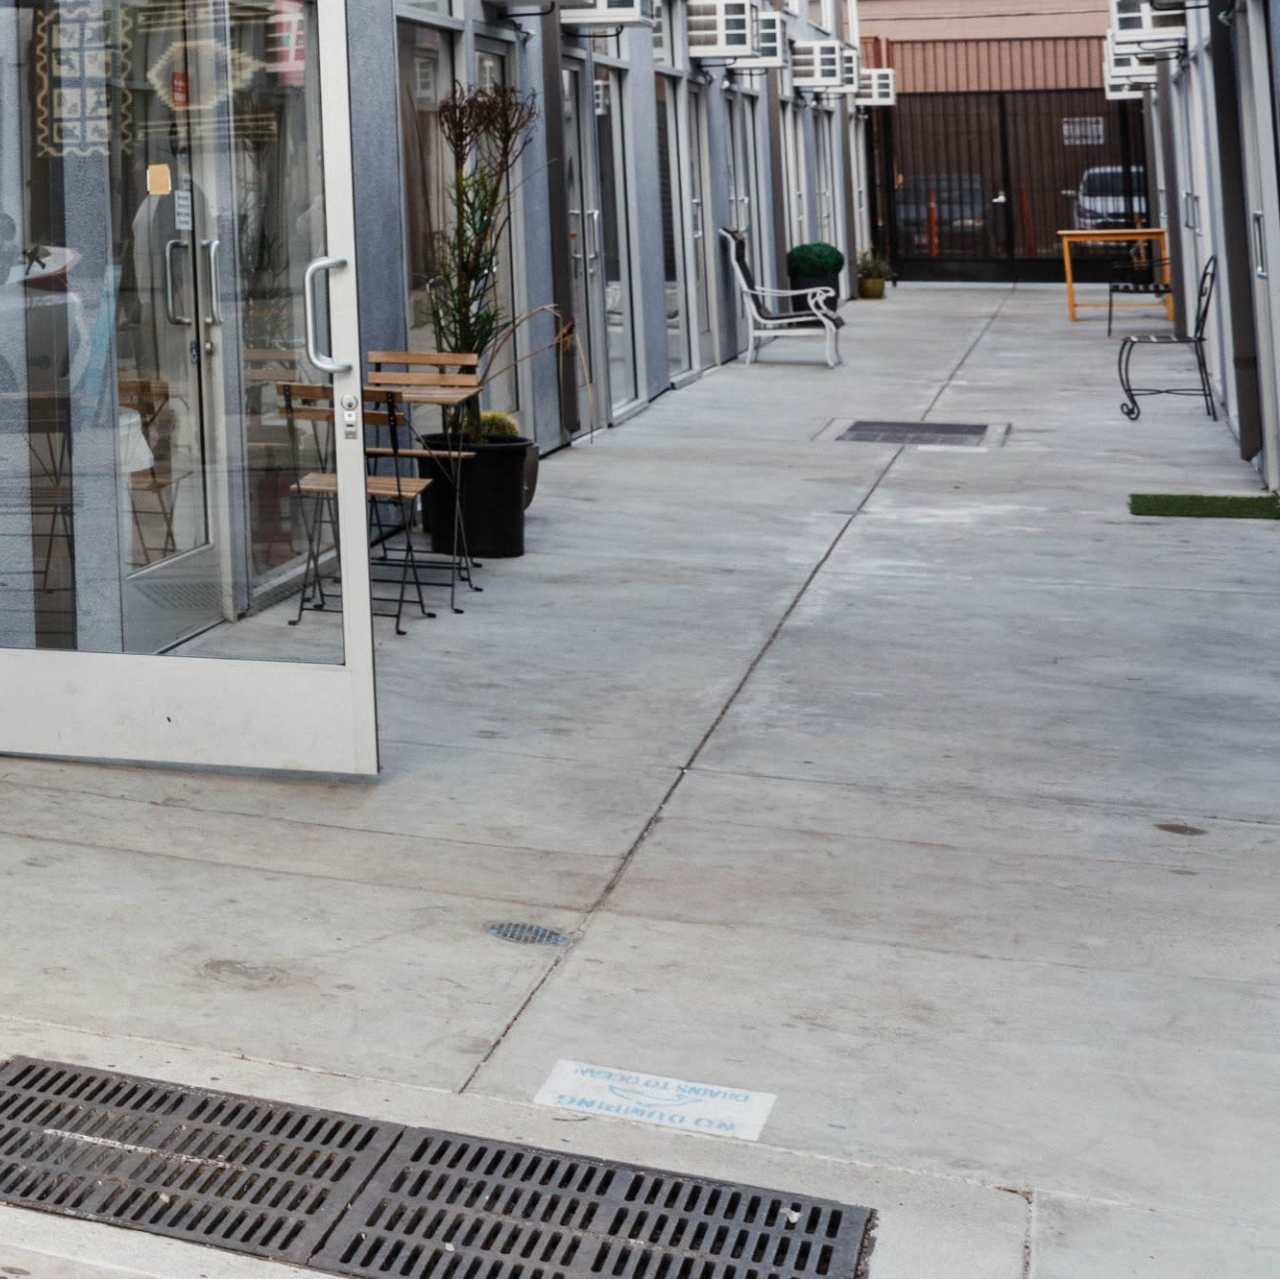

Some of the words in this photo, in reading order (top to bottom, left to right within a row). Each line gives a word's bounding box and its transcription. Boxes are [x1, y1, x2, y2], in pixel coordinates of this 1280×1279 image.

[643, 1078, 672, 1090] TO
[558, 1094, 688, 1125] DUMPING
[694, 1117, 737, 1132] NO
